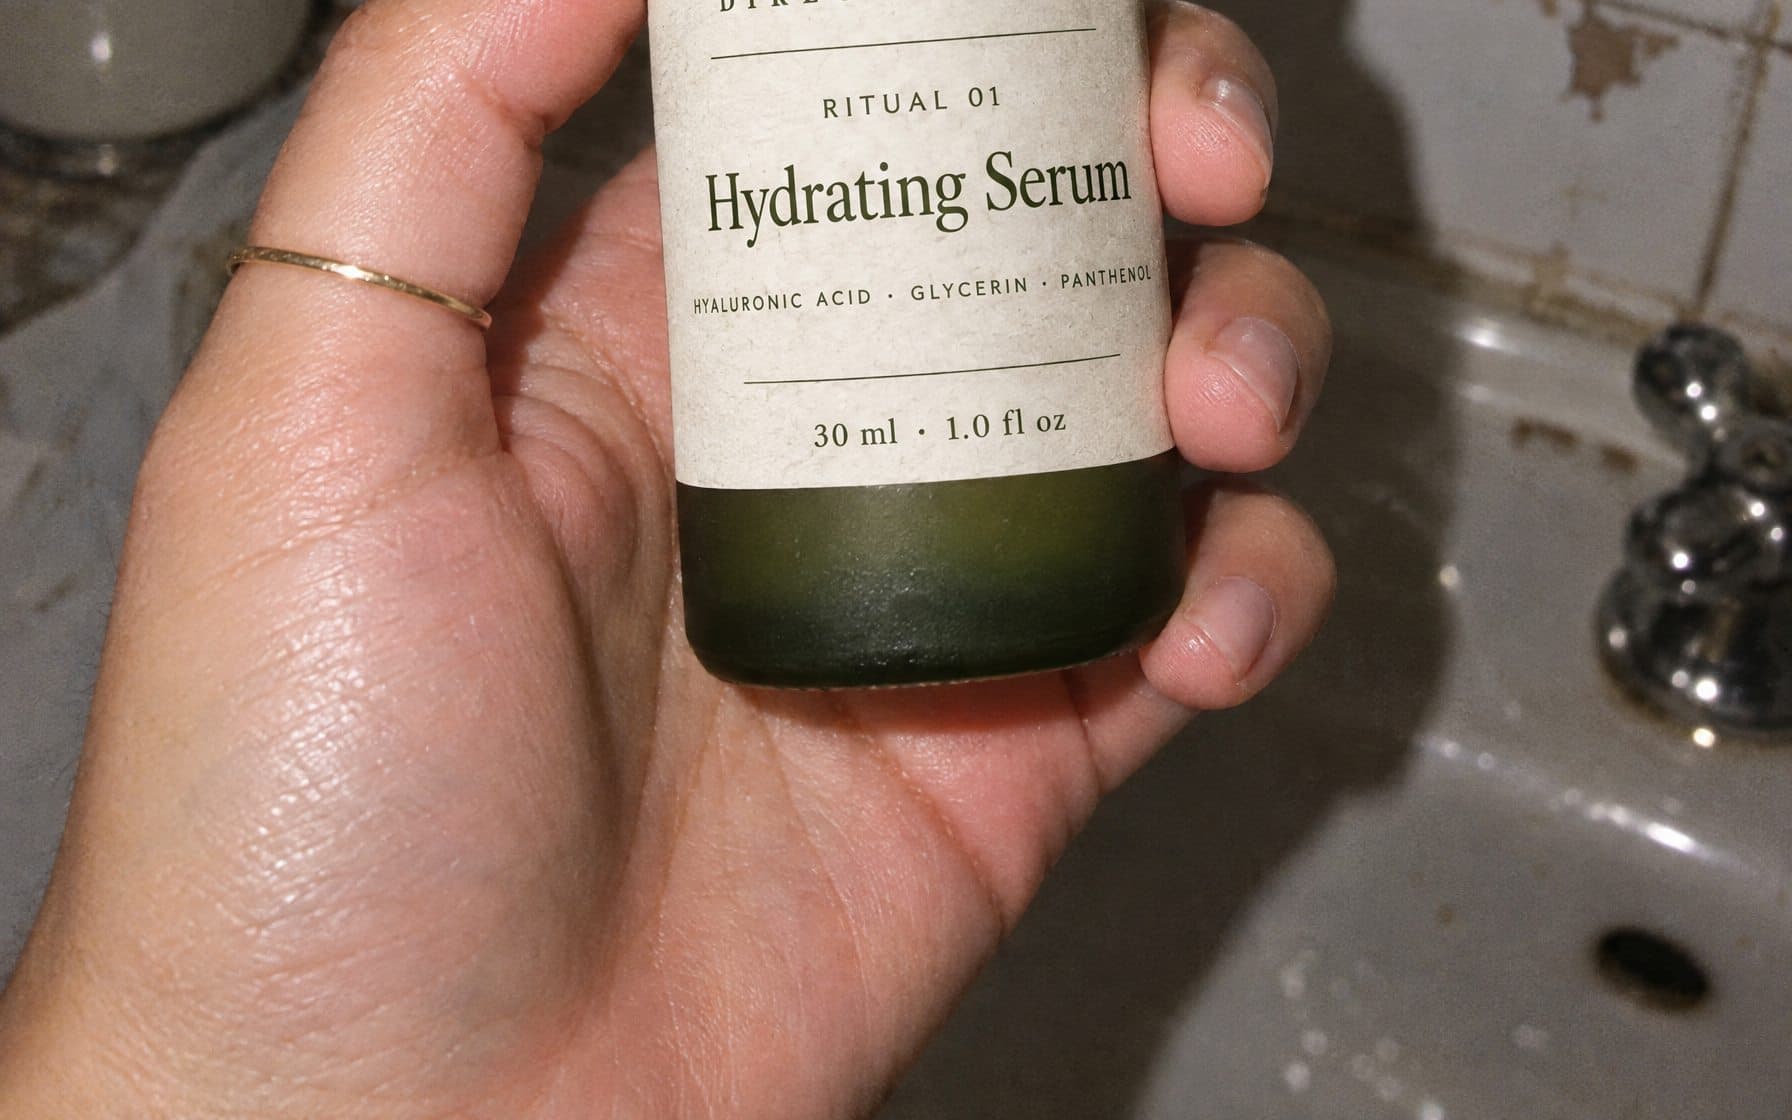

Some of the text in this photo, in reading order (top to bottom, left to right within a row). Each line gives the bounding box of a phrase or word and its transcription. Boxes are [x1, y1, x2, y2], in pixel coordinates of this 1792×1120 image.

[822, 85, 1001, 119] RITUAL 01
[704, 150, 1132, 249] Hydrating Serum
[693, 292, 803, 315] HYALURONIC
[816, 289, 871, 307] ACID
[910, 276, 1027, 301] GLYCERIN
[1060, 264, 1152, 290] PANTHENOL
[813, 422, 849, 448] 30
[860, 417, 899, 446] ml
[946, 413, 990, 441] 1.0
[1002, 407, 1025, 436] fl
[1036, 413, 1067, 433] oz
